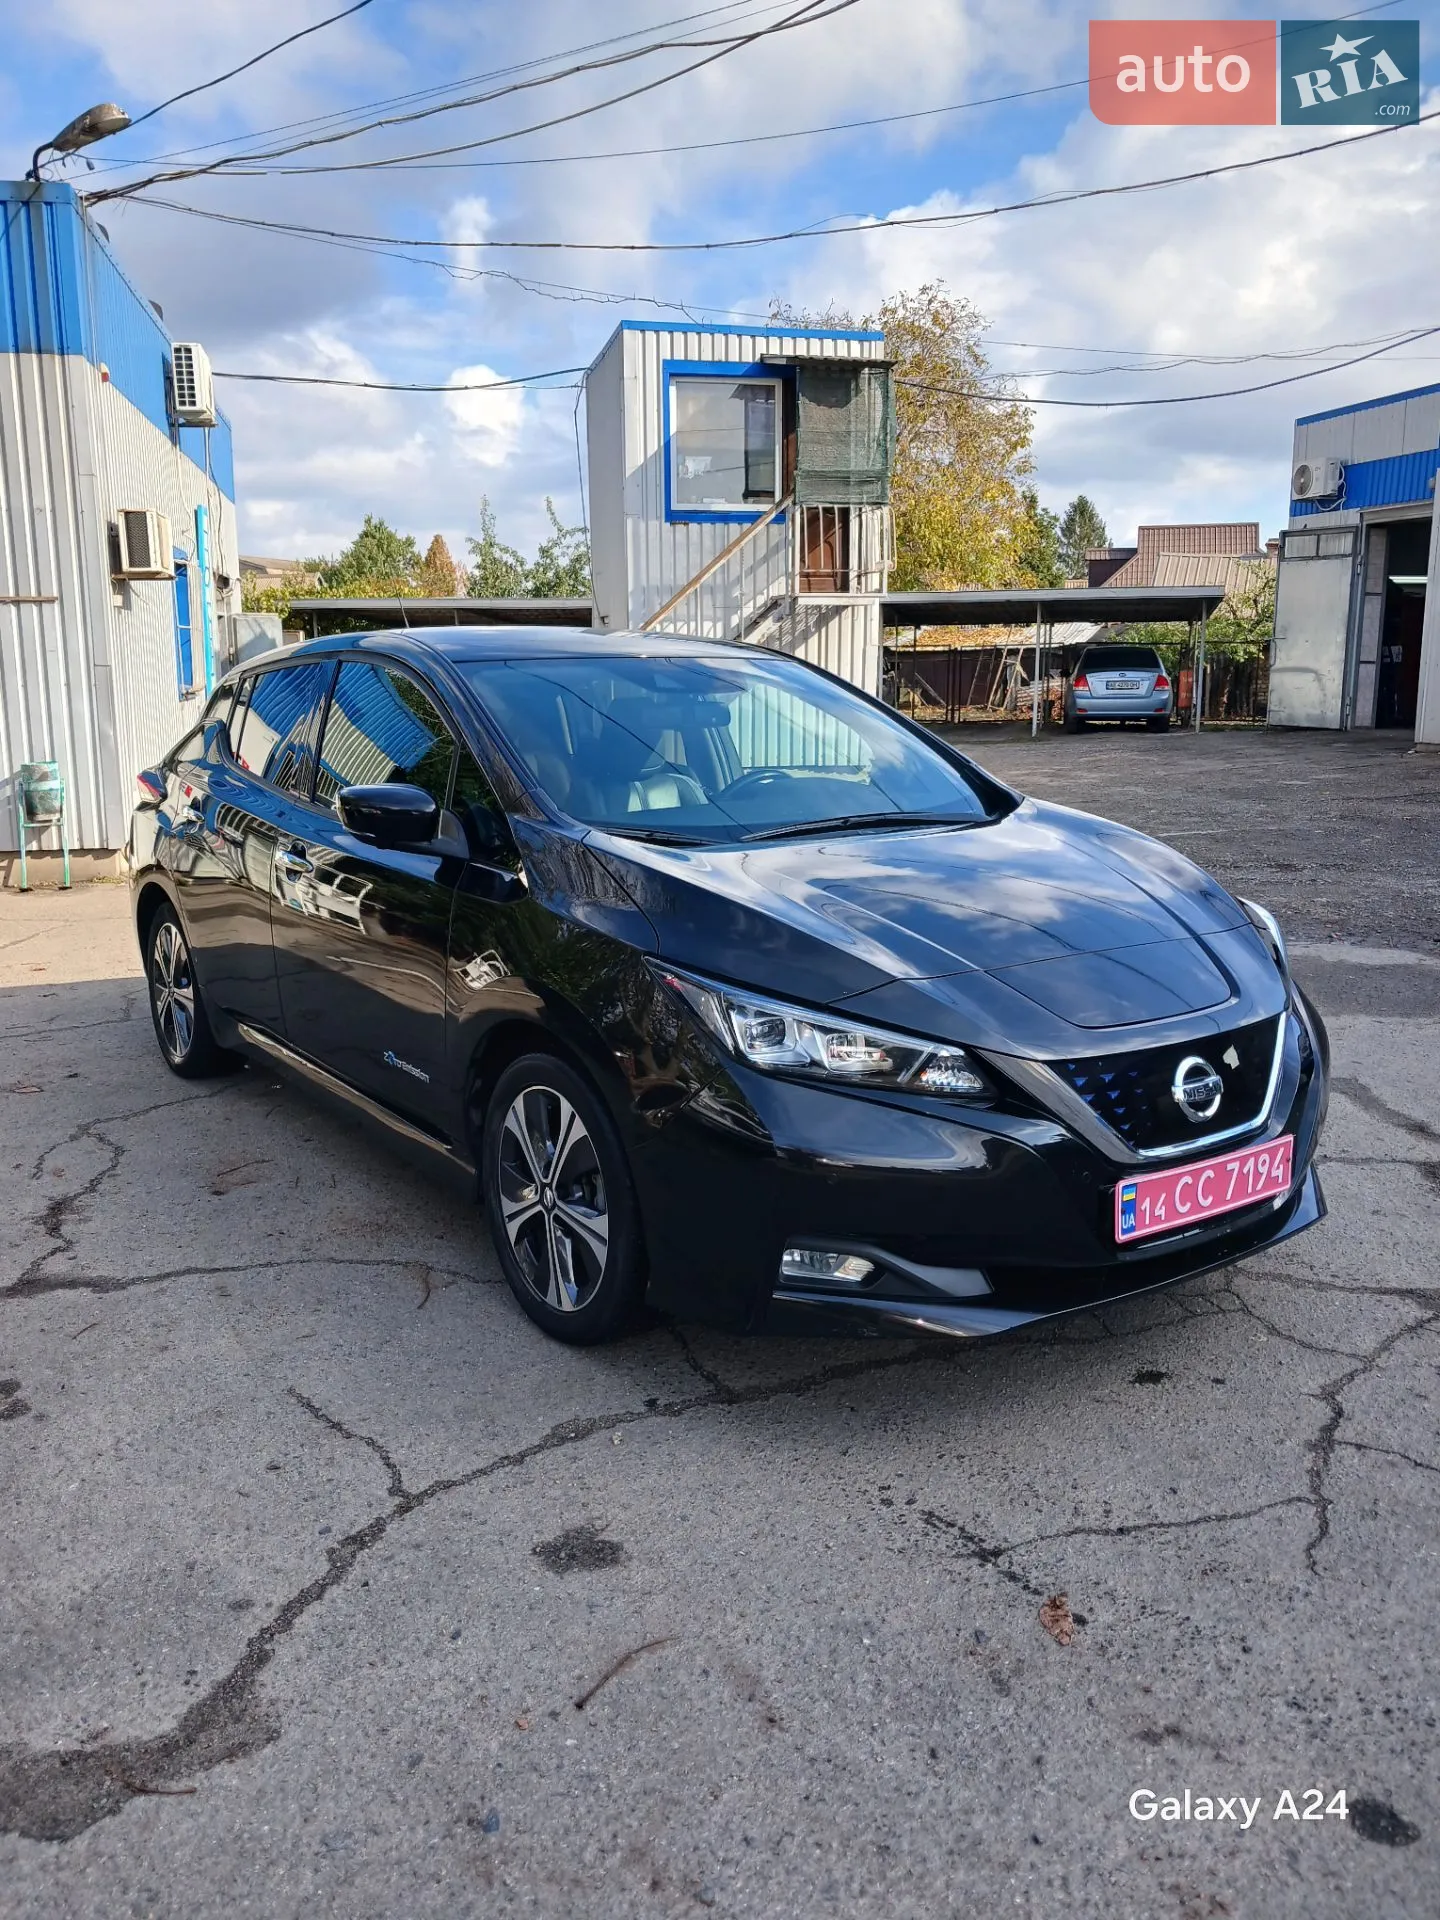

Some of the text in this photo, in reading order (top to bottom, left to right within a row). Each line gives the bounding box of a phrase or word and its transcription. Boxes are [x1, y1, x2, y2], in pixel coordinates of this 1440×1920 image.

[1140, 1147, 1285, 1224] 14 CC 7194
[1122, 1213, 1136, 1229] UA
